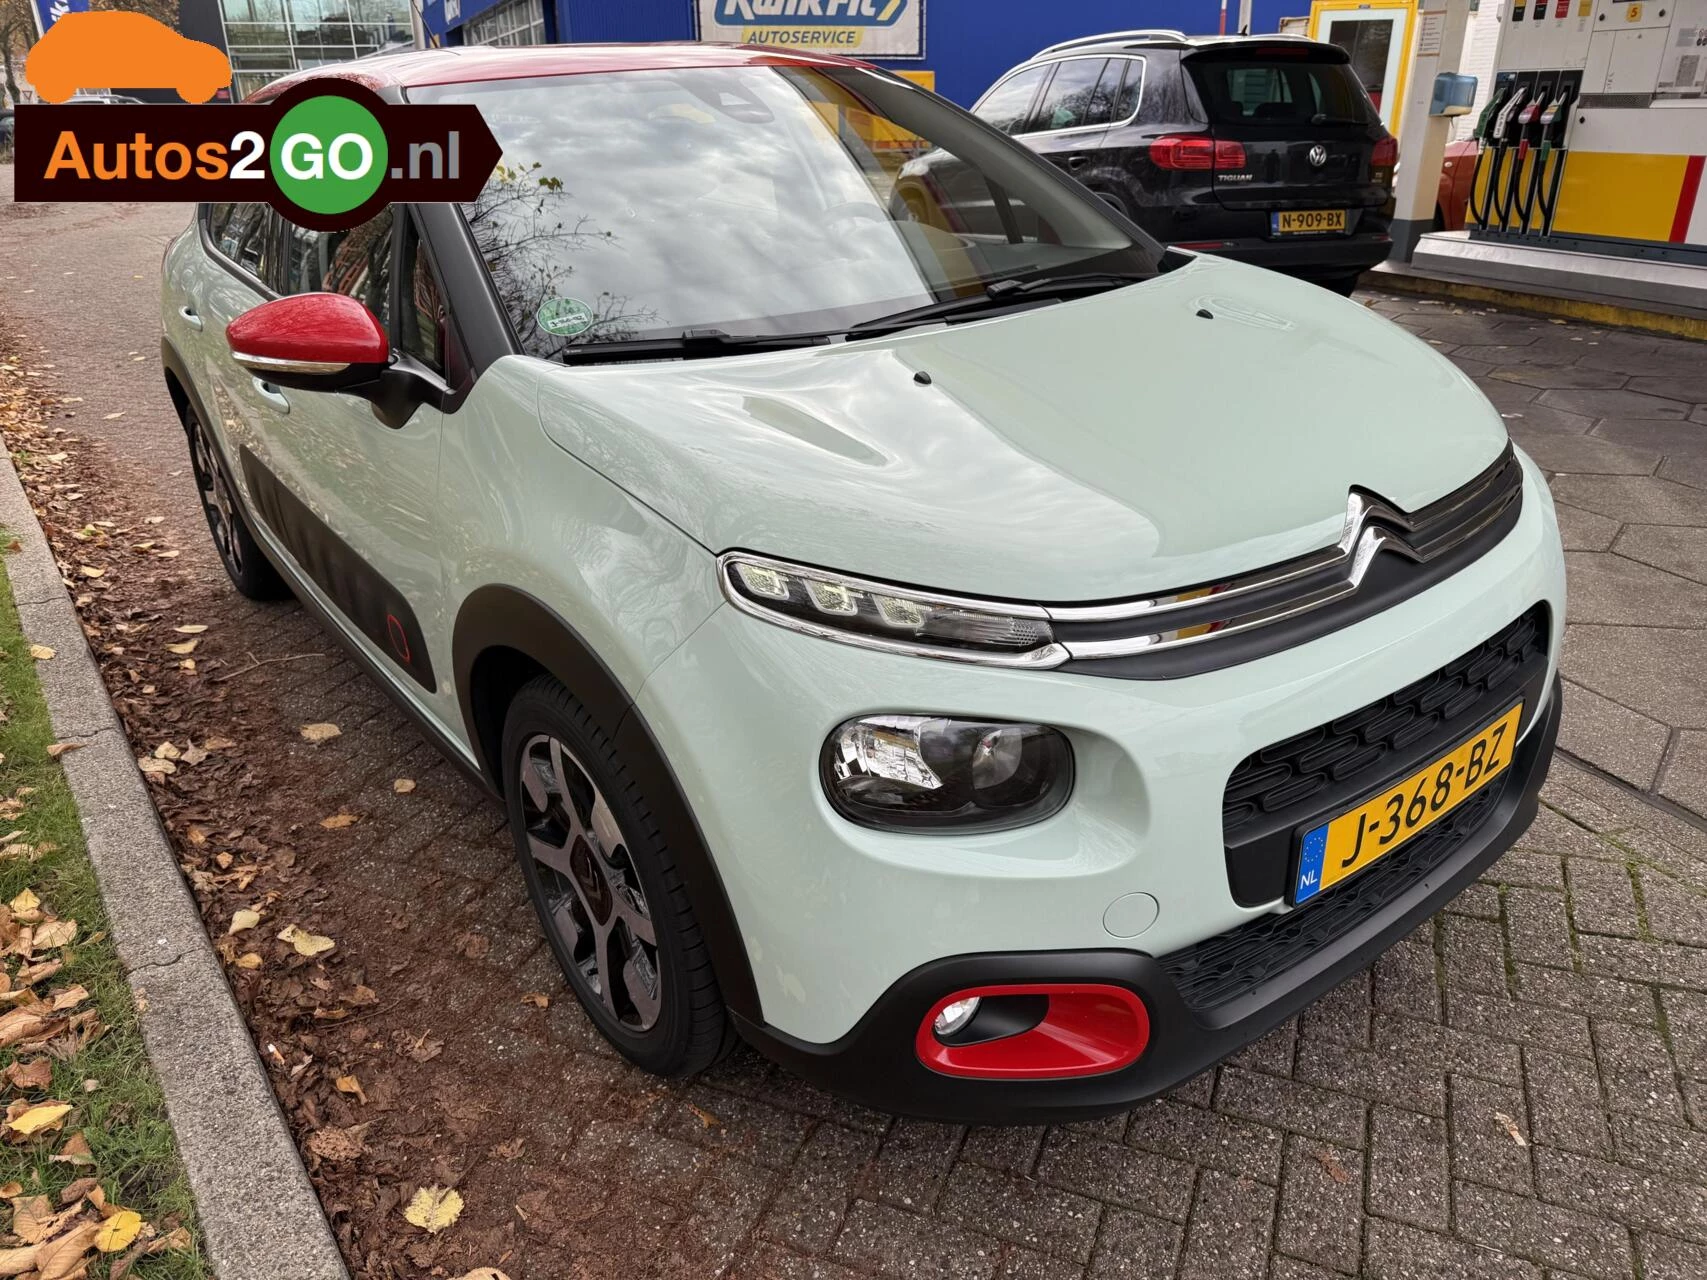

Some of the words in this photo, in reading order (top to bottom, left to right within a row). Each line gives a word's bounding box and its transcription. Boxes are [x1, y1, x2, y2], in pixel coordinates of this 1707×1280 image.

[1629, 7, 1638, 18] 5
[747, 30, 856, 44] AUTOSERVICE
[1217, 174, 1253, 182] TIGUAN
[1281, 211, 1342, 228] N-909-BX
[1300, 869, 1318, 889] NL
[1342, 721, 1508, 868] J-368-BZ
